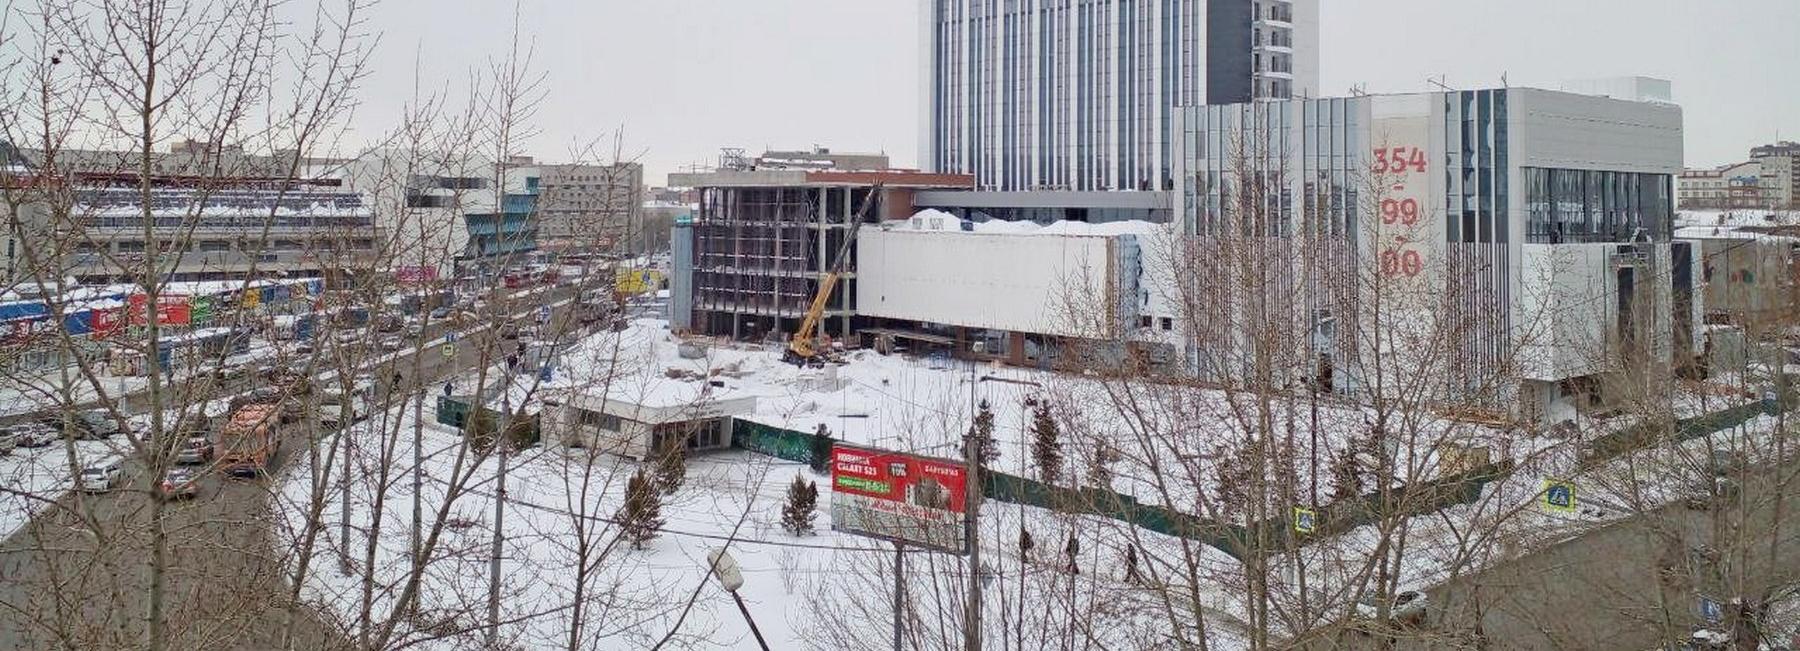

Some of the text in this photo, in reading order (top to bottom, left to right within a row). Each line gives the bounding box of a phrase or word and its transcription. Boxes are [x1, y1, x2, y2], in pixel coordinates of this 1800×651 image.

[1371, 147, 1427, 174] 354
[1381, 198, 1418, 225] 99
[1381, 250, 1422, 277] 00
